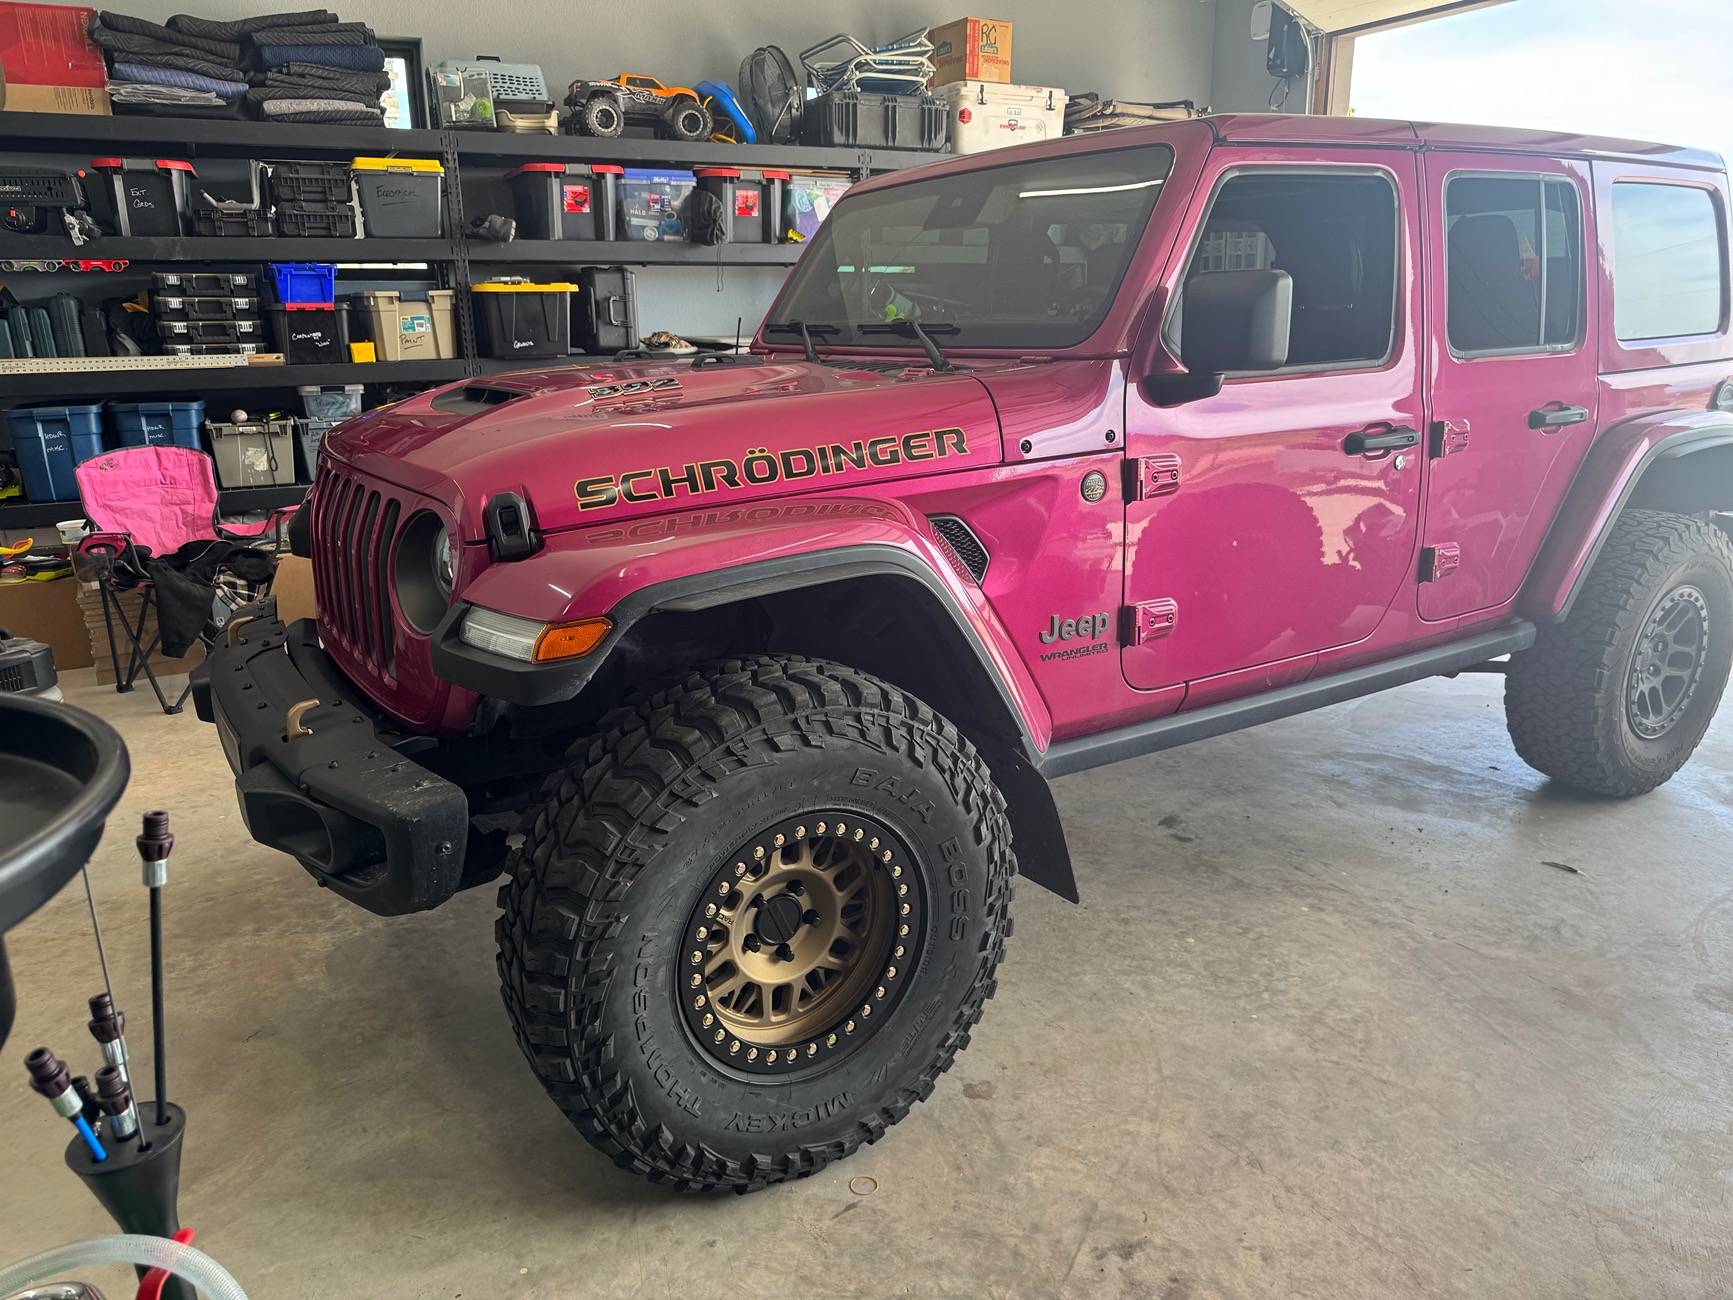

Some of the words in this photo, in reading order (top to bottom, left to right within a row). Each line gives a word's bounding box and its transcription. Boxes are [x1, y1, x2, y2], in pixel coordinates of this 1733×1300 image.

[981, 23, 997, 45] RC
[573, 427, 971, 511] SCHRÖDINGER
[1039, 612, 1110, 645] Jeep
[1040, 642, 1109, 662] WRANGLER
[850, 767, 936, 824] BAJA
[938, 836, 970, 941] BOSS
[719, 912, 735, 926] RAC
[722, 1090, 855, 1133] MICKEY
